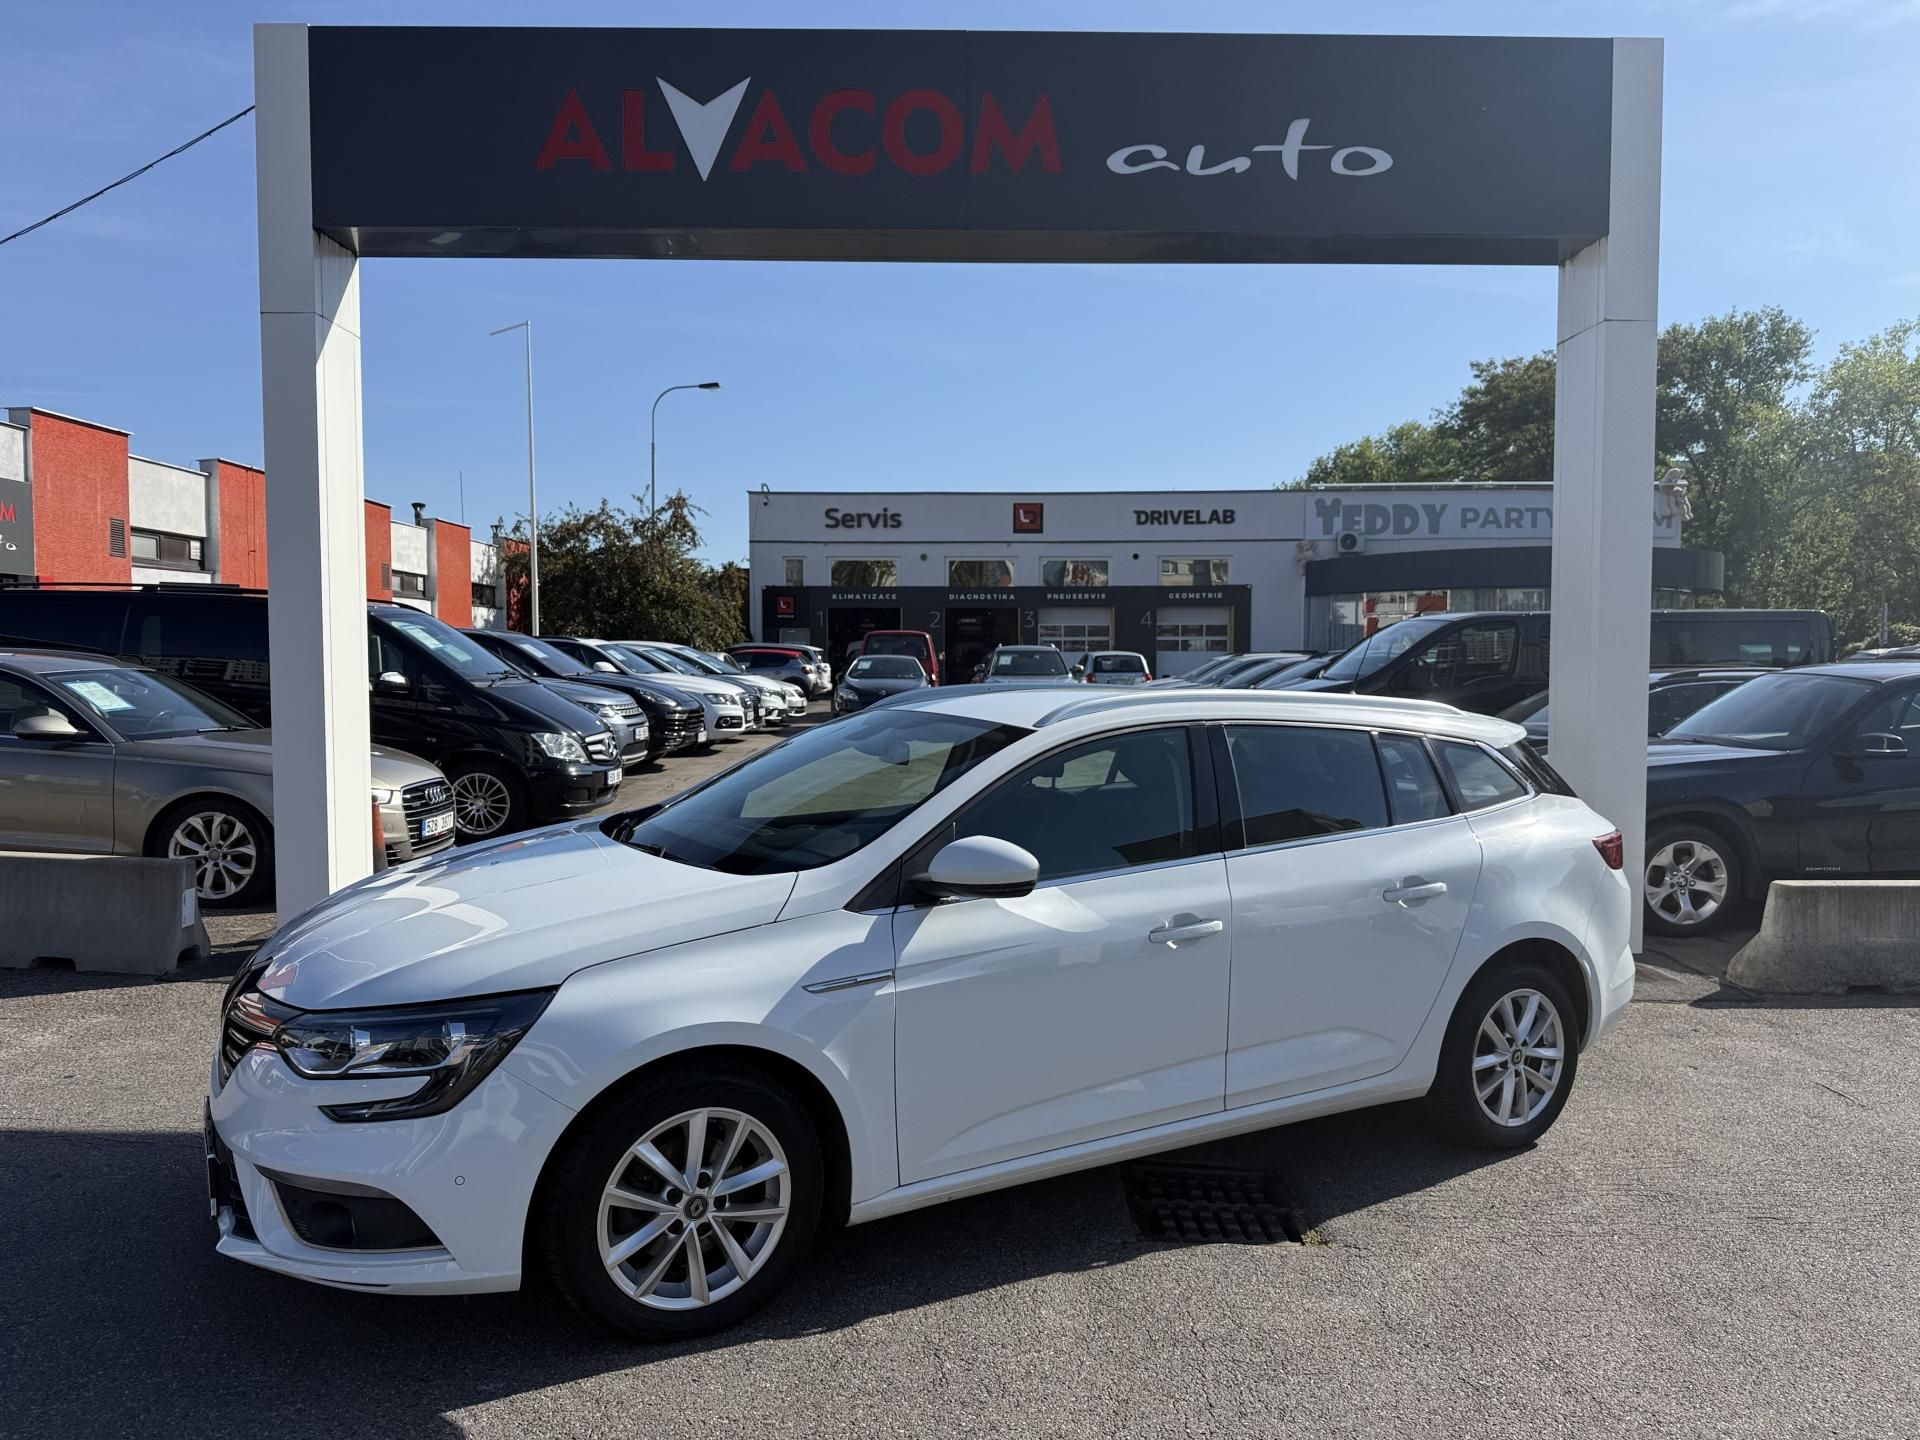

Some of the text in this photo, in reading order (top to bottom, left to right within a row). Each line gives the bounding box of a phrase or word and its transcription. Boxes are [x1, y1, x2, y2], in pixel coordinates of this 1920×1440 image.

[535, 76, 1393, 182] ALVACOM auto
[824, 507, 902, 529] Servis
[1133, 509, 1236, 526] DRIVELAB
[1314, 497, 1448, 536] TEDDY
[816, 611, 824, 628] 1
[929, 611, 941, 628] 2
[1024, 611, 1035, 628] 3
[1140, 611, 1152, 627] 4
